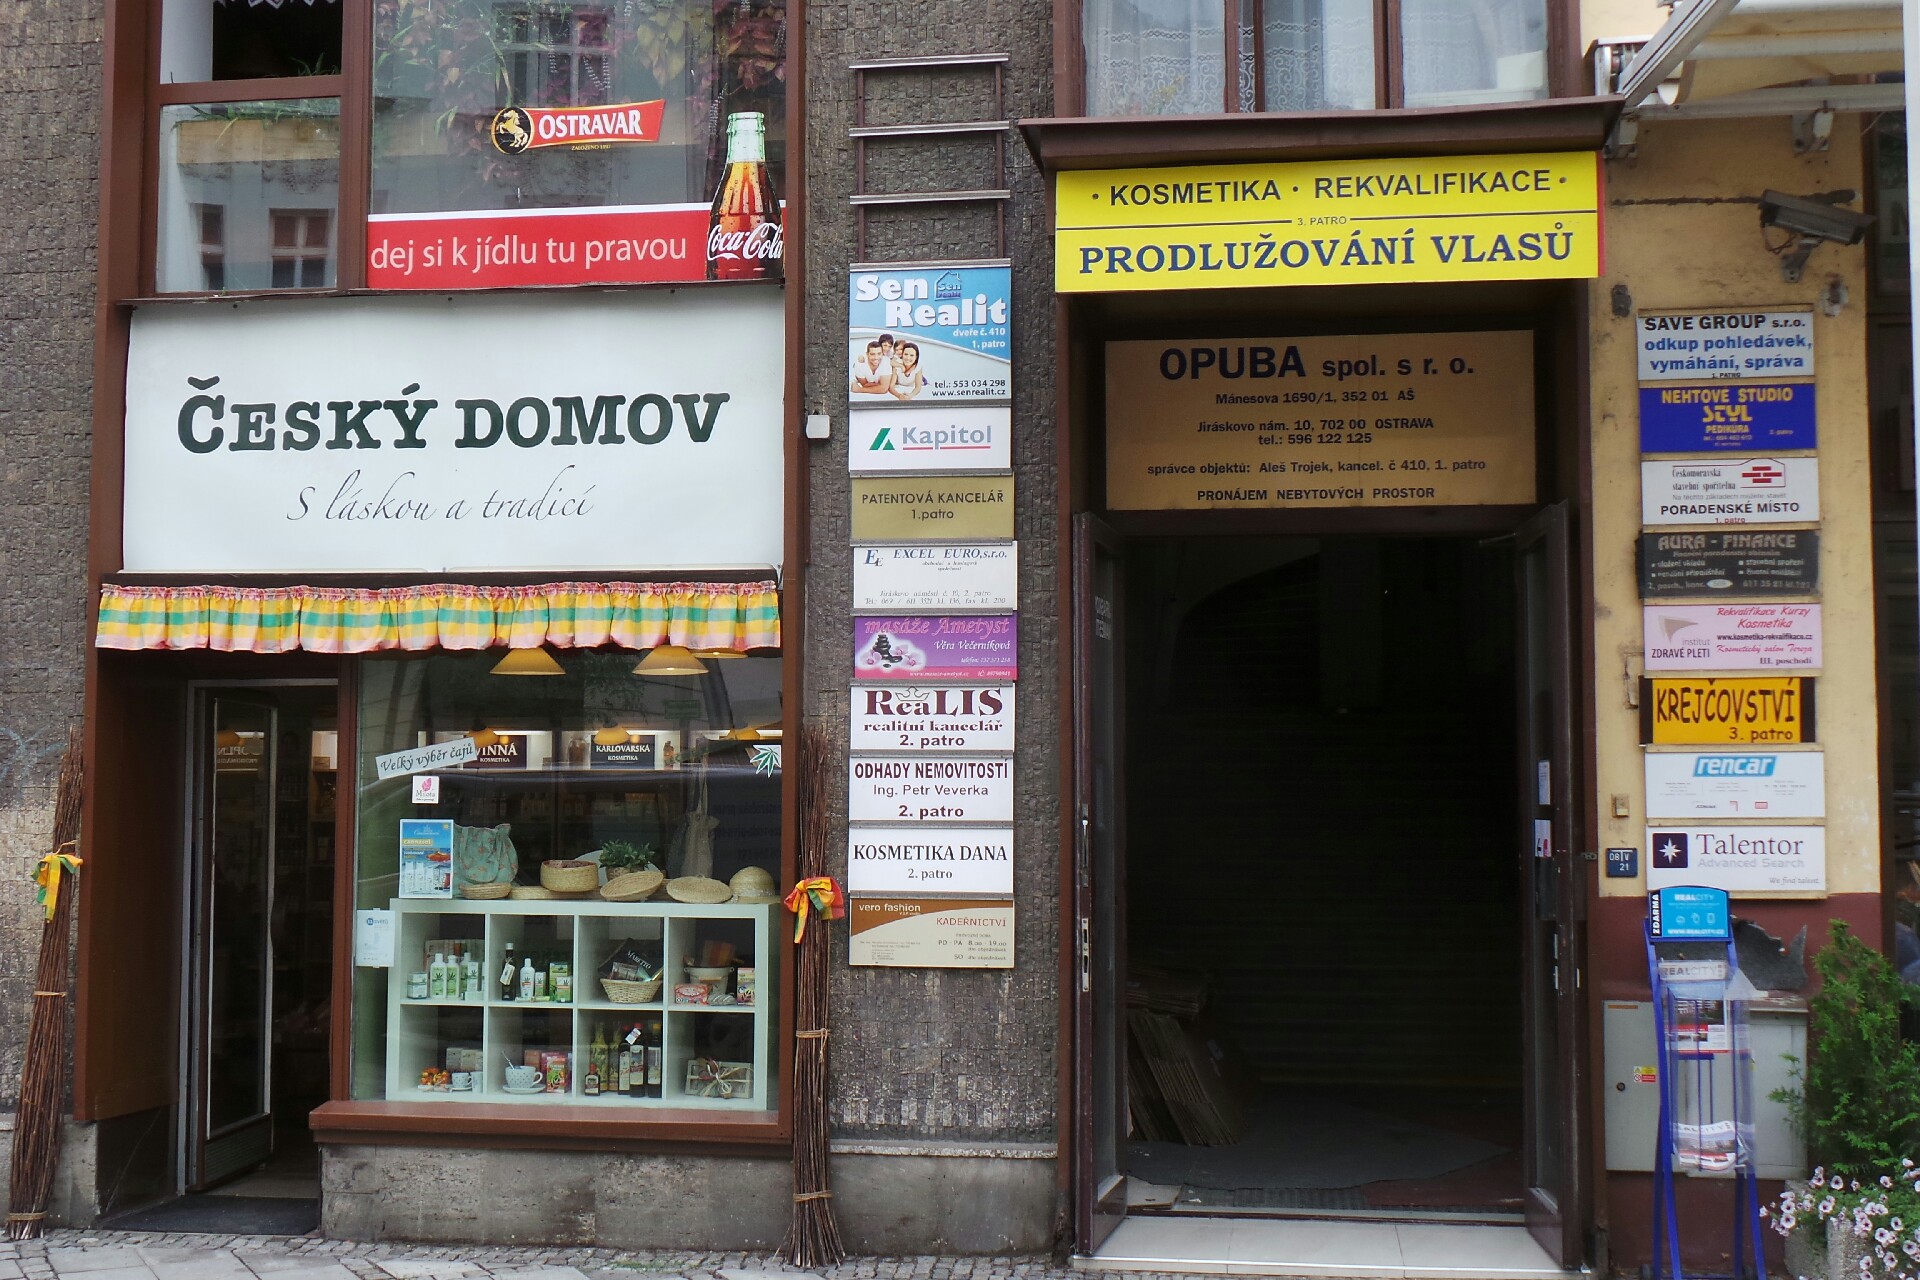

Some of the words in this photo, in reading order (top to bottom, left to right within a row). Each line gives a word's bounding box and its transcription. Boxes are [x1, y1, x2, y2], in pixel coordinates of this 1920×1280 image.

[538, 110, 643, 139] OSTRAVAR
[1110, 179, 1281, 206] KOSMETIKA
[1314, 170, 1551, 199] REKVALIFIKACE
[1297, 217, 1306, 226] 3.
[1310, 215, 1347, 226] PATRO
[707, 222, 784, 261] Coca-Cola
[1079, 227, 1415, 274] PRODLUŽOVÁNÍ
[1430, 222, 1573, 264] VLASŮ
[371, 239, 413, 276] dej
[422, 238, 442, 267] si
[453, 237, 467, 266] k
[473, 234, 536, 274] jídlu
[547, 238, 576, 263] tu
[585, 236, 686, 269] pravou
[856, 275, 928, 300] Sen
[885, 294, 1007, 327] Realit
[1644, 316, 1694, 330] SAVE
[1699, 315, 1766, 329] GROUP
[1772, 319, 1806, 328] s.r.o.
[953, 328, 978, 337] dveře
[980, 328, 987, 336] č.
[989, 328, 1005, 336] 410
[982, 340, 1005, 350] patro
[1645, 338, 1698, 352] odkup
[1704, 334, 1812, 352] pohledávek,
[1159, 346, 1306, 381] OPUBA
[1321, 355, 1386, 381] spol.
[1397, 359, 1411, 375] s
[1423, 358, 1438, 375] r.
[1449, 358, 1474, 374] o.
[1650, 355, 1739, 373] vymáhání,
[1744, 354, 1804, 370] správa
[935, 380, 950, 388] tel.:
[953, 380, 968, 388] 553
[932, 388, 1005, 397] www.senrealit.cz
[1215, 392, 1279, 405] Mánesova
[1283, 392, 1337, 406] 1690/1,
[1341, 392, 1366, 402] 352
[1371, 392, 1388, 402] 01
[1398, 388, 1415, 401] AŠ
[1738, 387, 1793, 402] STUDIO
[177, 375, 438, 454] ČESKÝ
[455, 392, 730, 449] DOMOV
[1702, 404, 1753, 423] STYL
[1197, 420, 1255, 432] Jiráskovo
[1259, 420, 1289, 431] nám.
[1294, 420, 1315, 432] 10,
[1320, 419, 1344, 430] 702
[1349, 419, 1366, 430] 00
[1375, 418, 1434, 430] OSTRAVA
[903, 425, 991, 450] Kapitol
[1258, 434, 1283, 445] tel.:
[1287, 434, 1312, 445] 596
[1317, 433, 1342, 444] 122
[1346, 433, 1372, 444] 125
[1147, 463, 1196, 476] správce
[1259, 460, 1286, 473] Aleš
[1290, 461, 1333, 474] Trojek,
[1338, 460, 1384, 472] kancel.
[1389, 459, 1396, 471] č
[1435, 459, 1448, 471] 1.
[1452, 459, 1486, 472] patro
[1672, 468, 1721, 478] Českomoravská
[286, 486, 316, 523] S
[324, 470, 438, 522] láskou
[445, 499, 471, 520] a
[482, 465, 595, 520] tradicí
[1197, 486, 1268, 501] PRONÁJEM
[1276, 486, 1363, 500] NEBYTOVÝCH
[1372, 487, 1435, 500] PROSTOR
[1672, 482, 1699, 490] stavební
[1703, 482, 1736, 492] spořitelna
[862, 490, 934, 504] PATENTOVÁ
[938, 489, 1003, 502] KANCELÁŘ
[911, 509, 954, 521] 1.patro
[1661, 500, 1752, 515] PORADENSKÉ
[1757, 500, 1799, 512] MÍSTO
[1658, 535, 1706, 550] AURA
[1723, 534, 1796, 549] FINANCE
[894, 549, 935, 558] EXCEL
[944, 549, 1007, 559] EURO,s.r.o.
[1717, 608, 1776, 616] Rekvalifikace
[1780, 606, 1810, 617] Kurzy
[865, 617, 930, 634] masáže
[933, 617, 1010, 639] Ametyst
[1737, 618, 1793, 628] Kosmetika
[934, 640, 955, 650] Věra
[958, 639, 1010, 652] Večerníková
[1652, 647, 1684, 658] ZDRAVÉ
[1687, 648, 1710, 658] PLETI
[1776, 656, 1812, 666] poschodí
[864, 688, 1002, 717] ReaLIS
[1657, 678, 1795, 724] KREJČOVSTVÍ
[864, 720, 925, 731] realitní
[930, 720, 1002, 731] kancelář
[900, 735, 914, 746] 2.
[921, 735, 965, 748] patro
[1729, 727, 1744, 740] 3.
[1751, 729, 1793, 743] patro
[596, 744, 650, 752] KARLOVARSKÁ
[381, 756, 414, 772] Velký
[416, 749, 447, 768] výběr
[450, 743, 474, 760] čajů
[855, 763, 910, 778] ODHADY
[915, 758, 1008, 778] NEMOVITOSTÍ
[1697, 758, 1772, 774] rencar
[874, 785, 898, 797] Ing.
[903, 785, 930, 795] Petr
[935, 785, 988, 795] Veverka
[899, 805, 913, 816] 2.
[920, 805, 964, 819] patro
[1696, 834, 1804, 855] Talentor
[853, 844, 955, 861] KOSMETIKA
[960, 845, 1007, 861] DANA
[1697, 858, 1757, 868] Advanced
[1762, 858, 1805, 868] Search
[908, 868, 918, 879] 2.
[921, 869, 952, 881] patro
[859, 904, 880, 912] vero
[884, 903, 921, 912] fashion
[1652, 894, 1660, 934] ZDARMA
[936, 916, 1006, 927] KADEŘNICTVÍ
